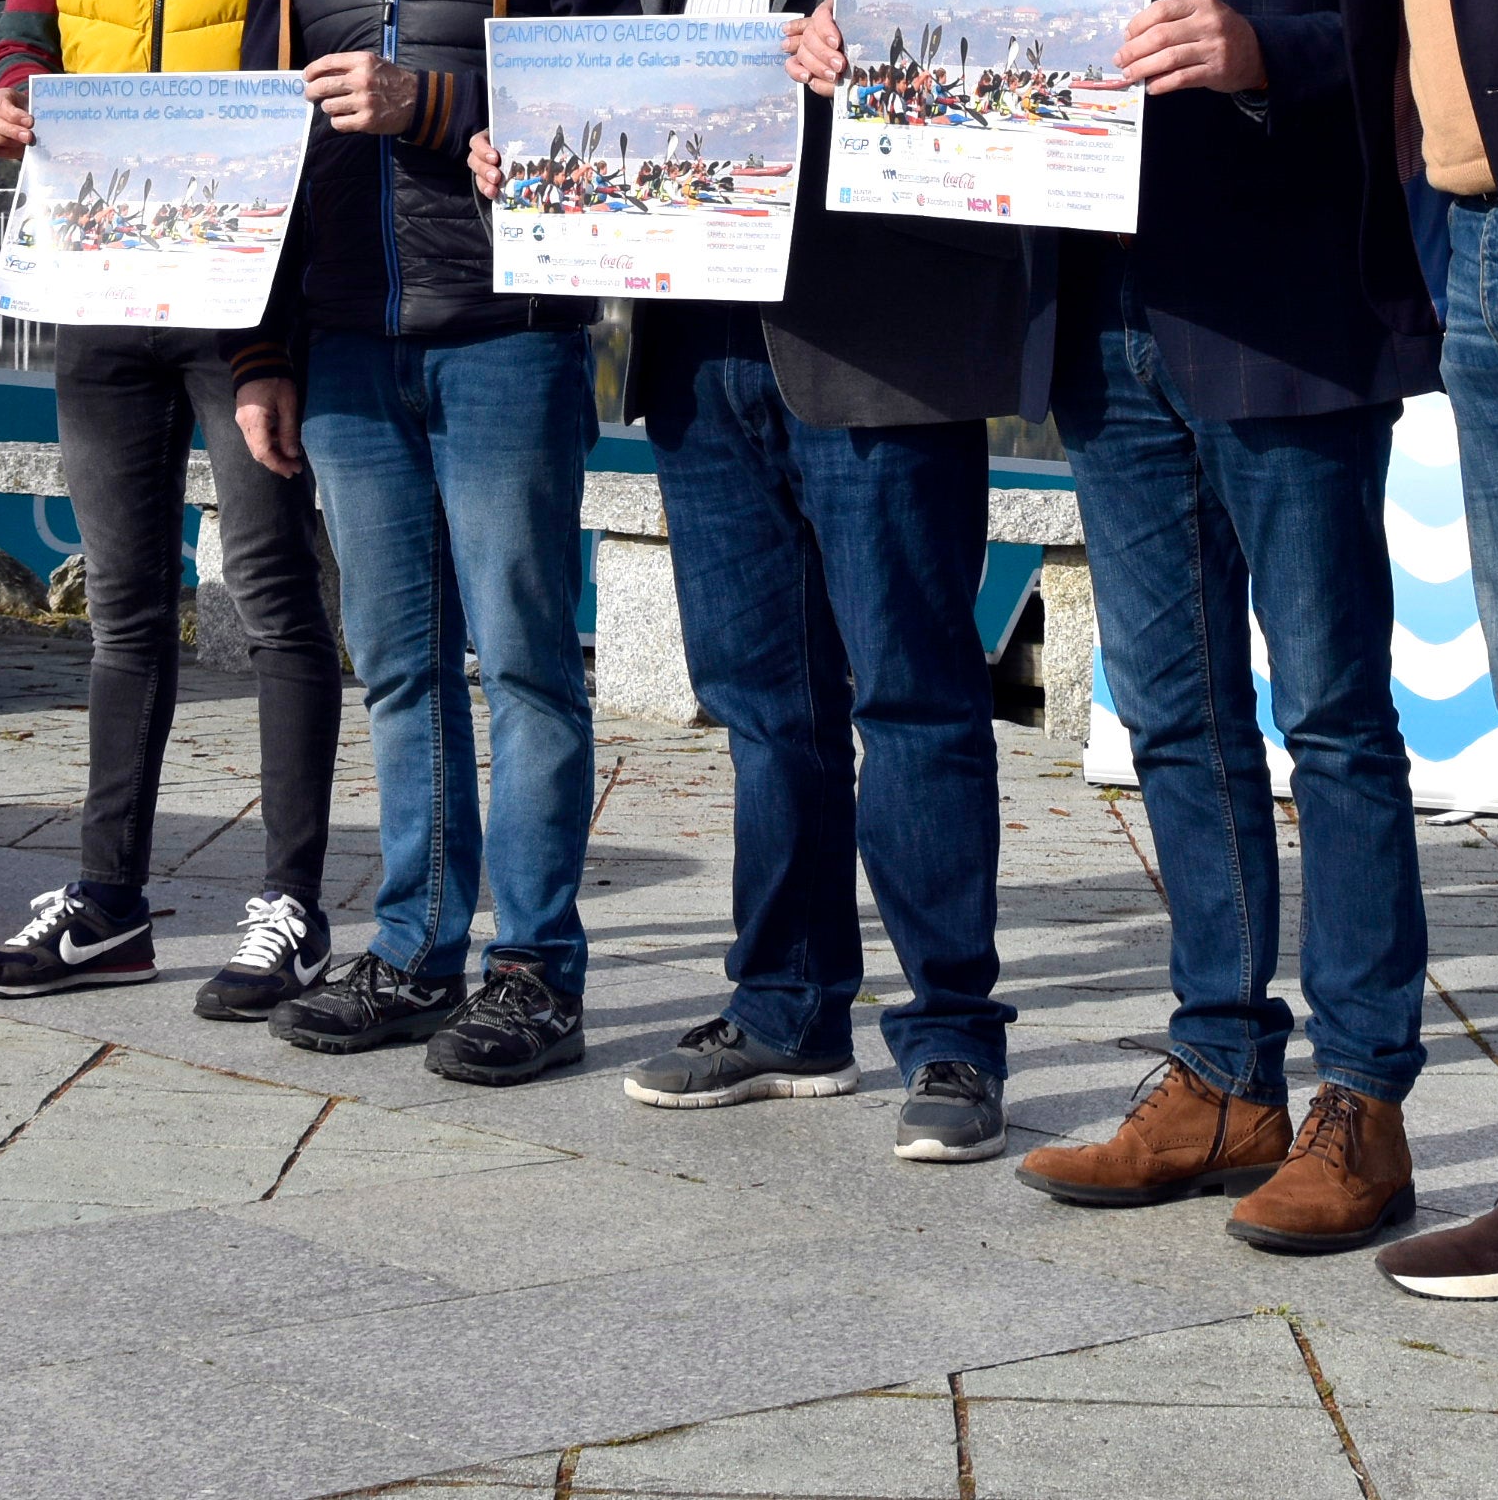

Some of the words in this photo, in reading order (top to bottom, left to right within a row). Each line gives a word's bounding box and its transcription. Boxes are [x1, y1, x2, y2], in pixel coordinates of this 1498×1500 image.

[492, 24, 607, 43] CAMPIONATO
[613, 23, 680, 42] GALEGO
[686, 22, 708, 41] DE
[494, 53, 572, 71] Campionato
[577, 53, 611, 67] Xunta
[615, 52, 633, 67] de
[638, 52, 681, 67] Galicia
[695, 50, 738, 66] 5000
[34, 80, 133, 98] CAMPIONATO
[139, 79, 203, 97] GALEGO
[208, 79, 229, 96] DE
[235, 78, 304, 96] INVERNO
[34, 106, 102, 123] Campionato
[105, 106, 139, 120] Xunta
[143, 105, 160, 120] de
[163, 105, 204, 120] Galicia
[218, 104, 259, 119] 5000
